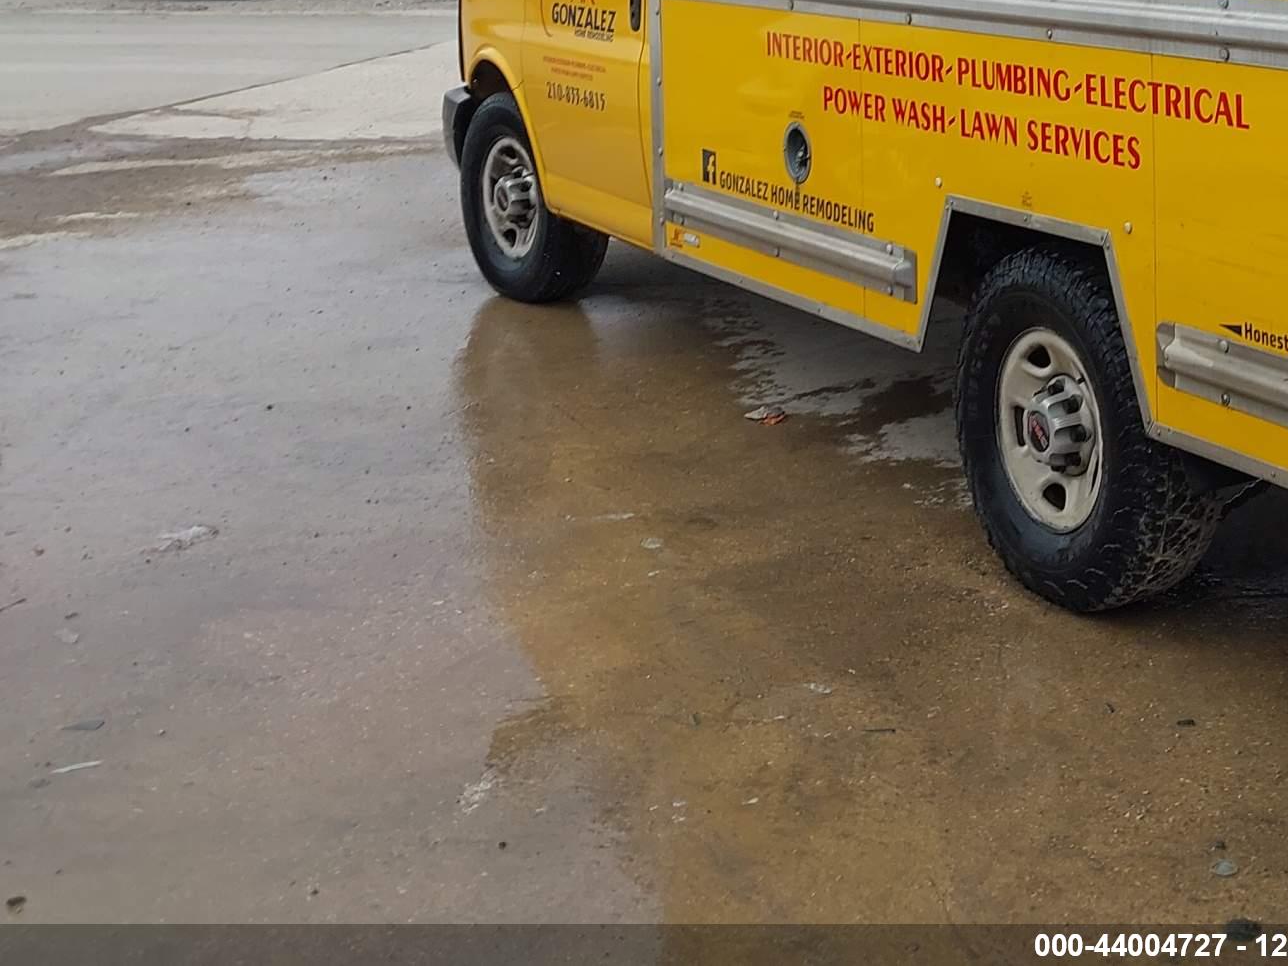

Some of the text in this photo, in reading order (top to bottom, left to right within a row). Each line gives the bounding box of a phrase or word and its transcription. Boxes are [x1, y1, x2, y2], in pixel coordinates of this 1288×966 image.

[551, 2, 617, 33] GONZALEZ
[823, 86, 887, 123] POWER
[1027, 121, 1141, 171] SERVICES
[719, 170, 875, 234] GONZALEZ HOME REMODELING
